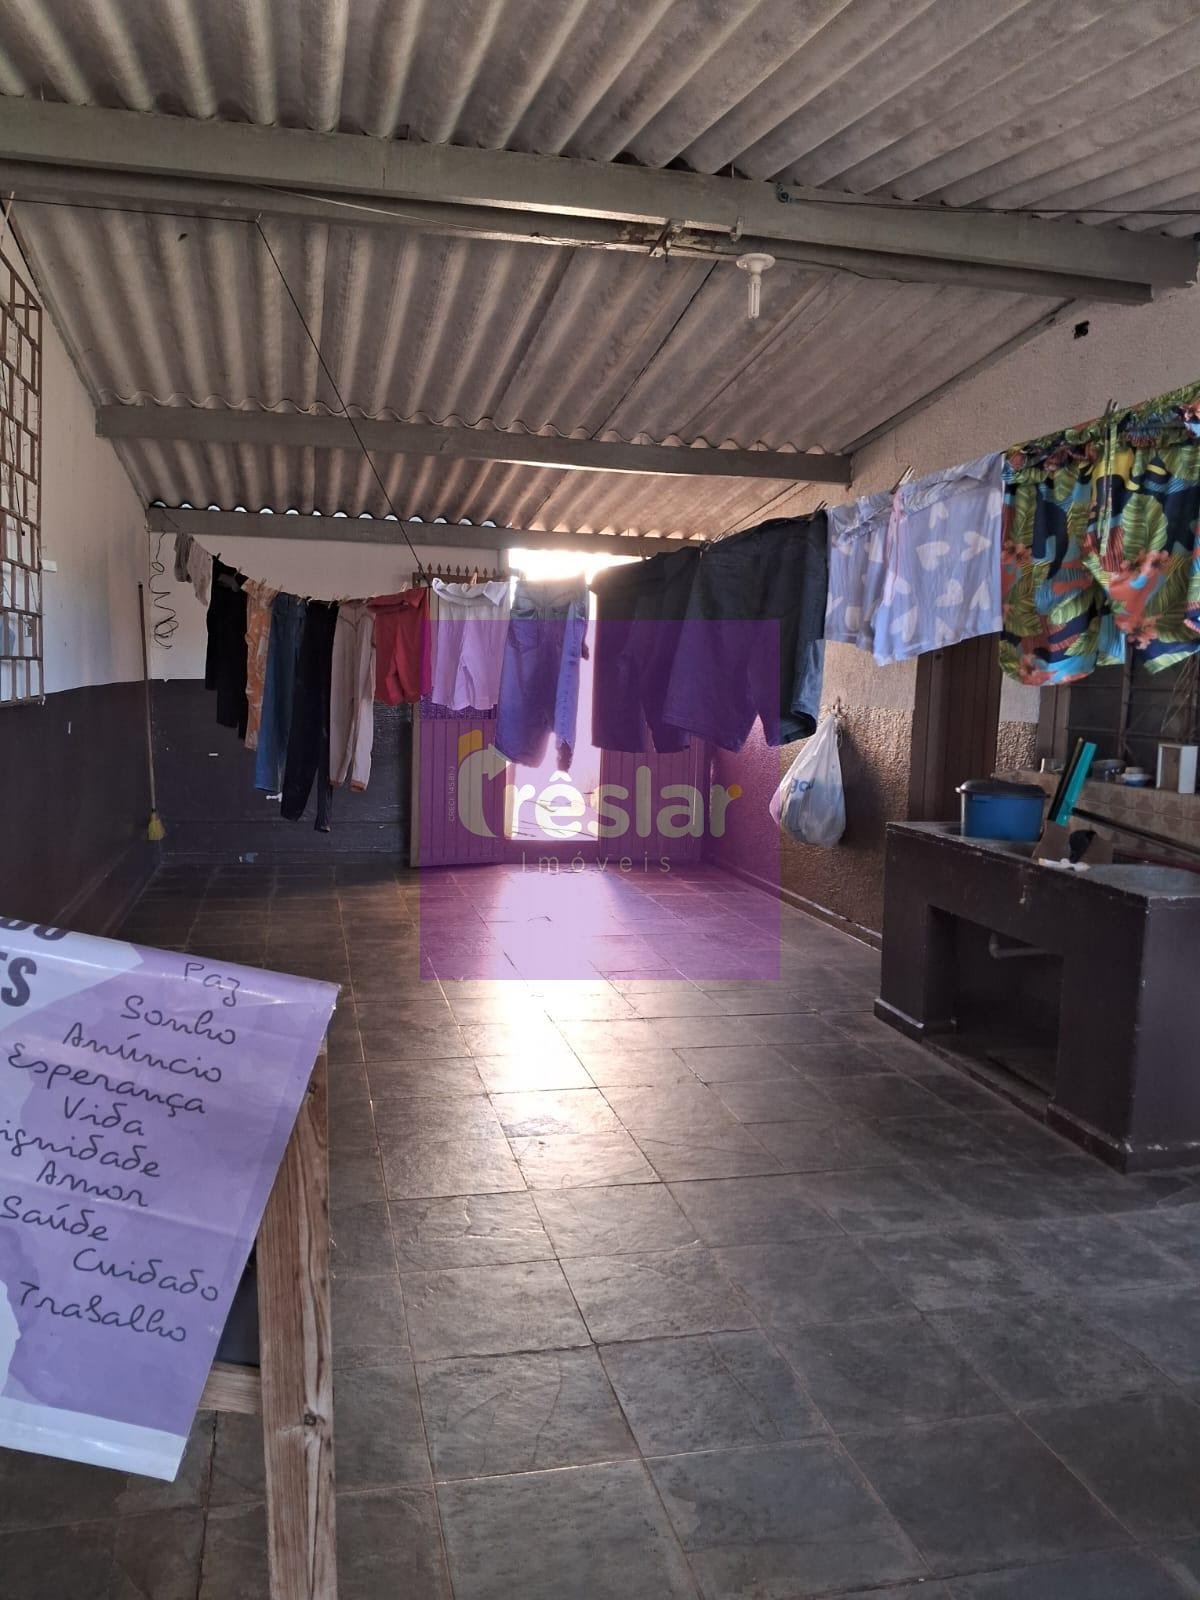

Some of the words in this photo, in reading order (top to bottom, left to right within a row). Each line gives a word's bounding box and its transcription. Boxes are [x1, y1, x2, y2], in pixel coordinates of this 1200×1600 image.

[184, 962, 240, 1007] Paz
[120, 995, 236, 1045] Sonho
[62, 1022, 223, 1083] Anúncio
[8, 1043, 205, 1118] Esperança
[64, 1096, 145, 1136] Vida
[36, 1160, 149, 1207] Amor
[0, 1195, 109, 1241] Saúde
[73, 1248, 219, 1301] Cuidado
[17, 1281, 187, 1342] Trabalho
